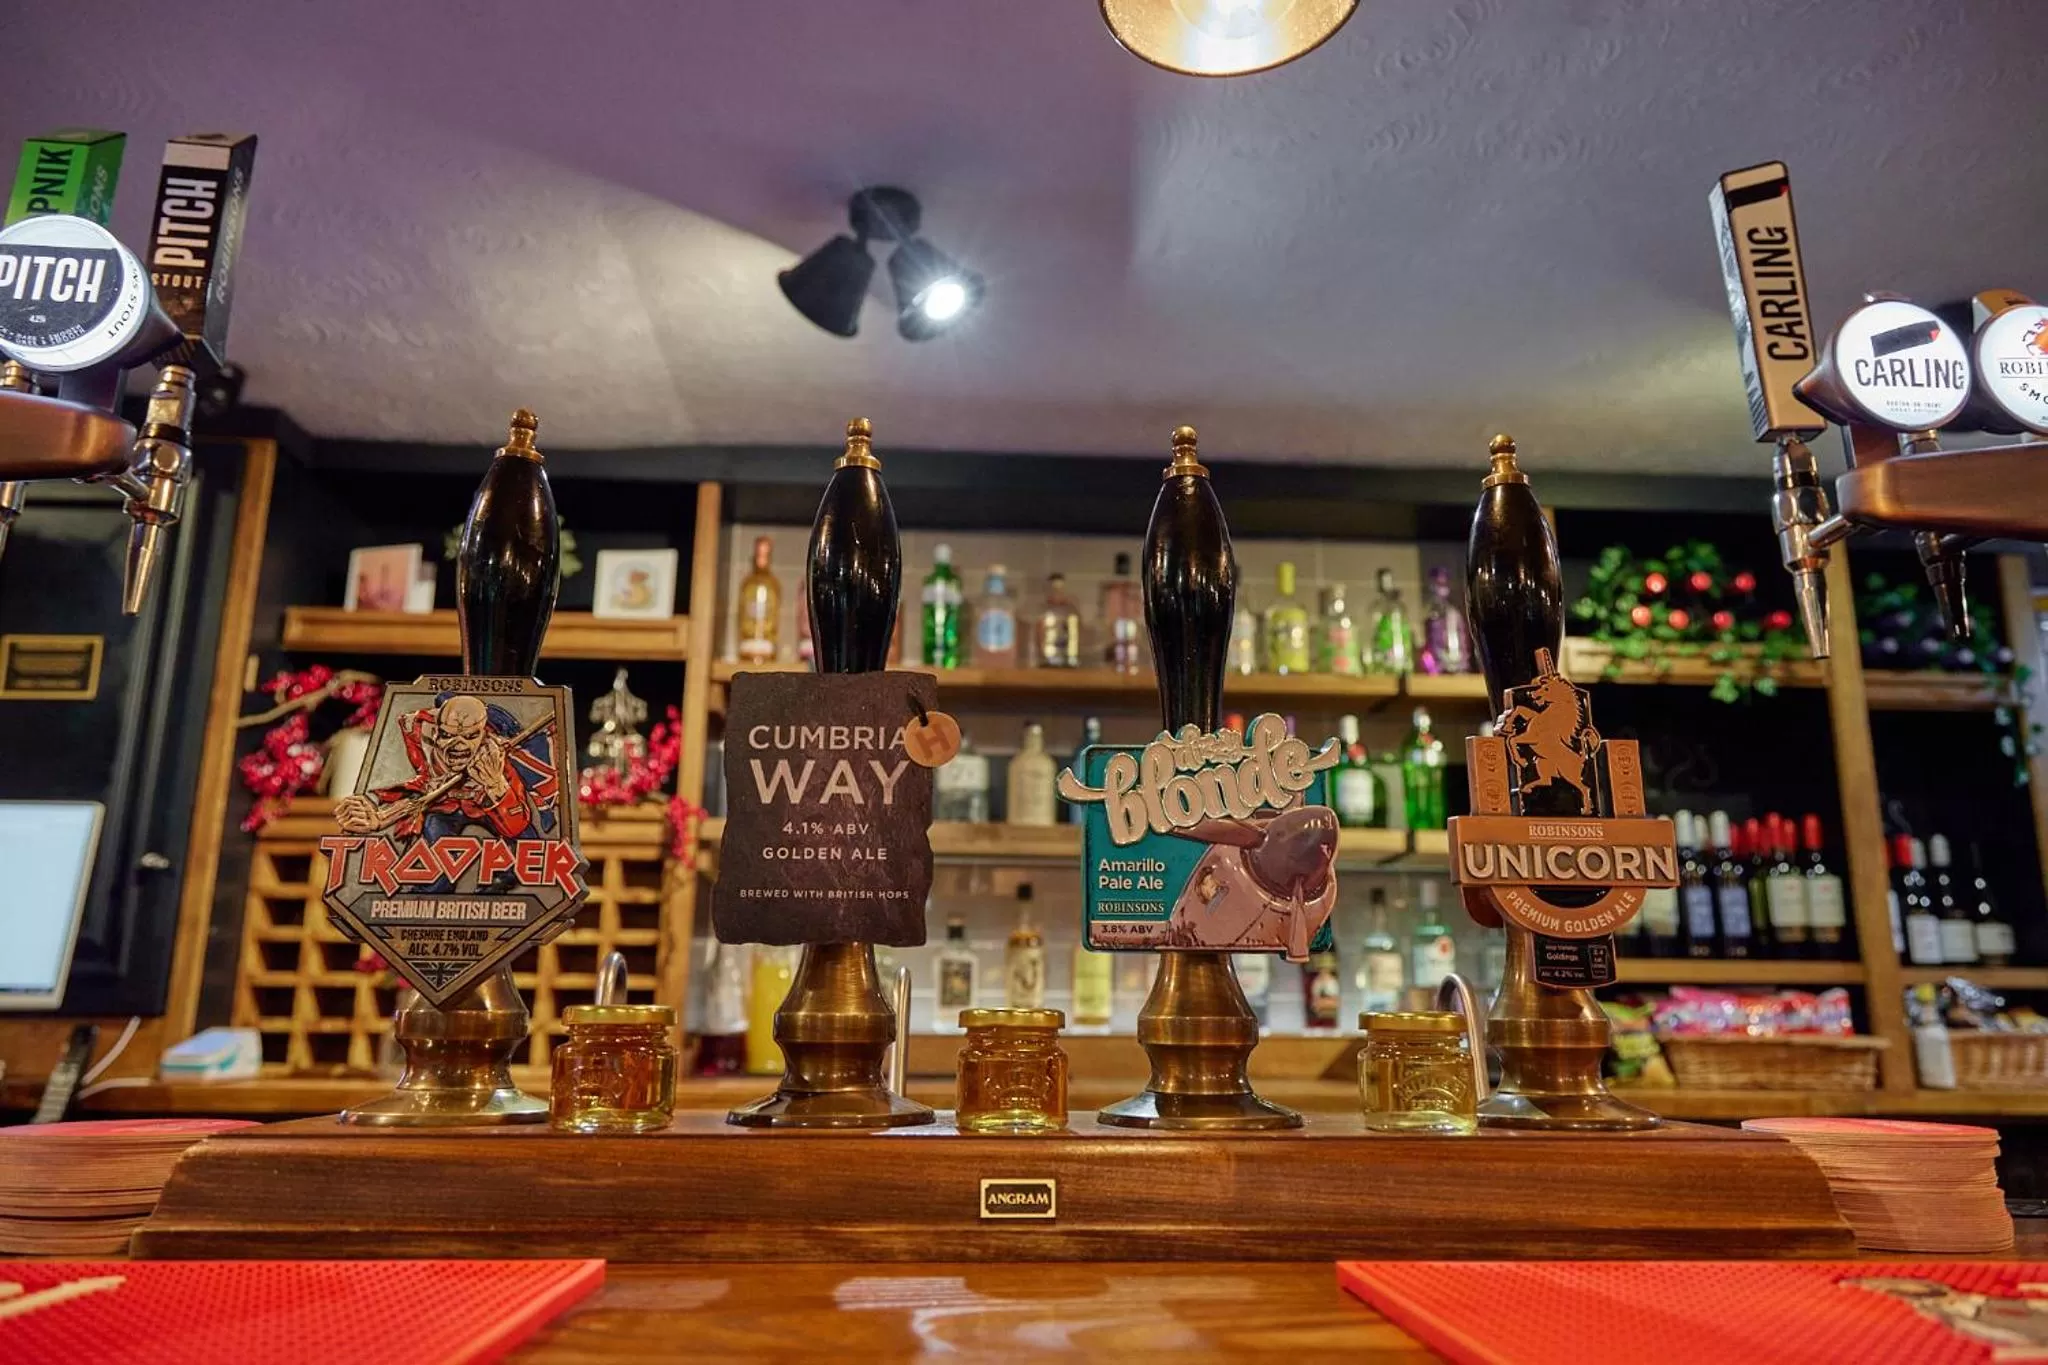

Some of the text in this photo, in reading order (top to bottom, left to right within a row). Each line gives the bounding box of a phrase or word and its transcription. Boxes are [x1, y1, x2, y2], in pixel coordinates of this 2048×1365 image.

[154, 178, 218, 268] PITCH
[0, 254, 106, 303] PITCH
[151, 272, 203, 289] STOUT
[1747, 226, 1809, 361] CARLING
[1854, 358, 1965, 389] CARLING
[428, 677, 524, 692] ROBINSONS
[749, 725, 906, 750] CUMBRIA
[749, 759, 909, 805] WAY
[1056, 712, 1340, 846] blonde
[782, 821, 870, 835] 4.1% ABV
[1529, 824, 1604, 837] ROBINSONS
[762, 847, 888, 860] GOLDEN ALE
[1464, 843, 1676, 880] UNICORN
[320, 836, 581, 899] TROOPER
[1098, 858, 1166, 872] Amarillo
[1099, 875, 1164, 889] Pale Ale
[739, 889, 909, 899] BREWED WITH BRITISH HOPS
[370, 900, 527, 920] PREMIUM BRITISH BEER
[1097, 902, 1165, 913] ROBINSONS
[1506, 891, 1637, 933] PREMIUM GOLDEN ALE
[401, 929, 488, 941] CHESHIRE ENGLAND
[1101, 924, 1153, 933] 3.8% ABV
[432, 943, 459, 956] 4.7%
[986, 1193, 1049, 1204] ANGRAM
